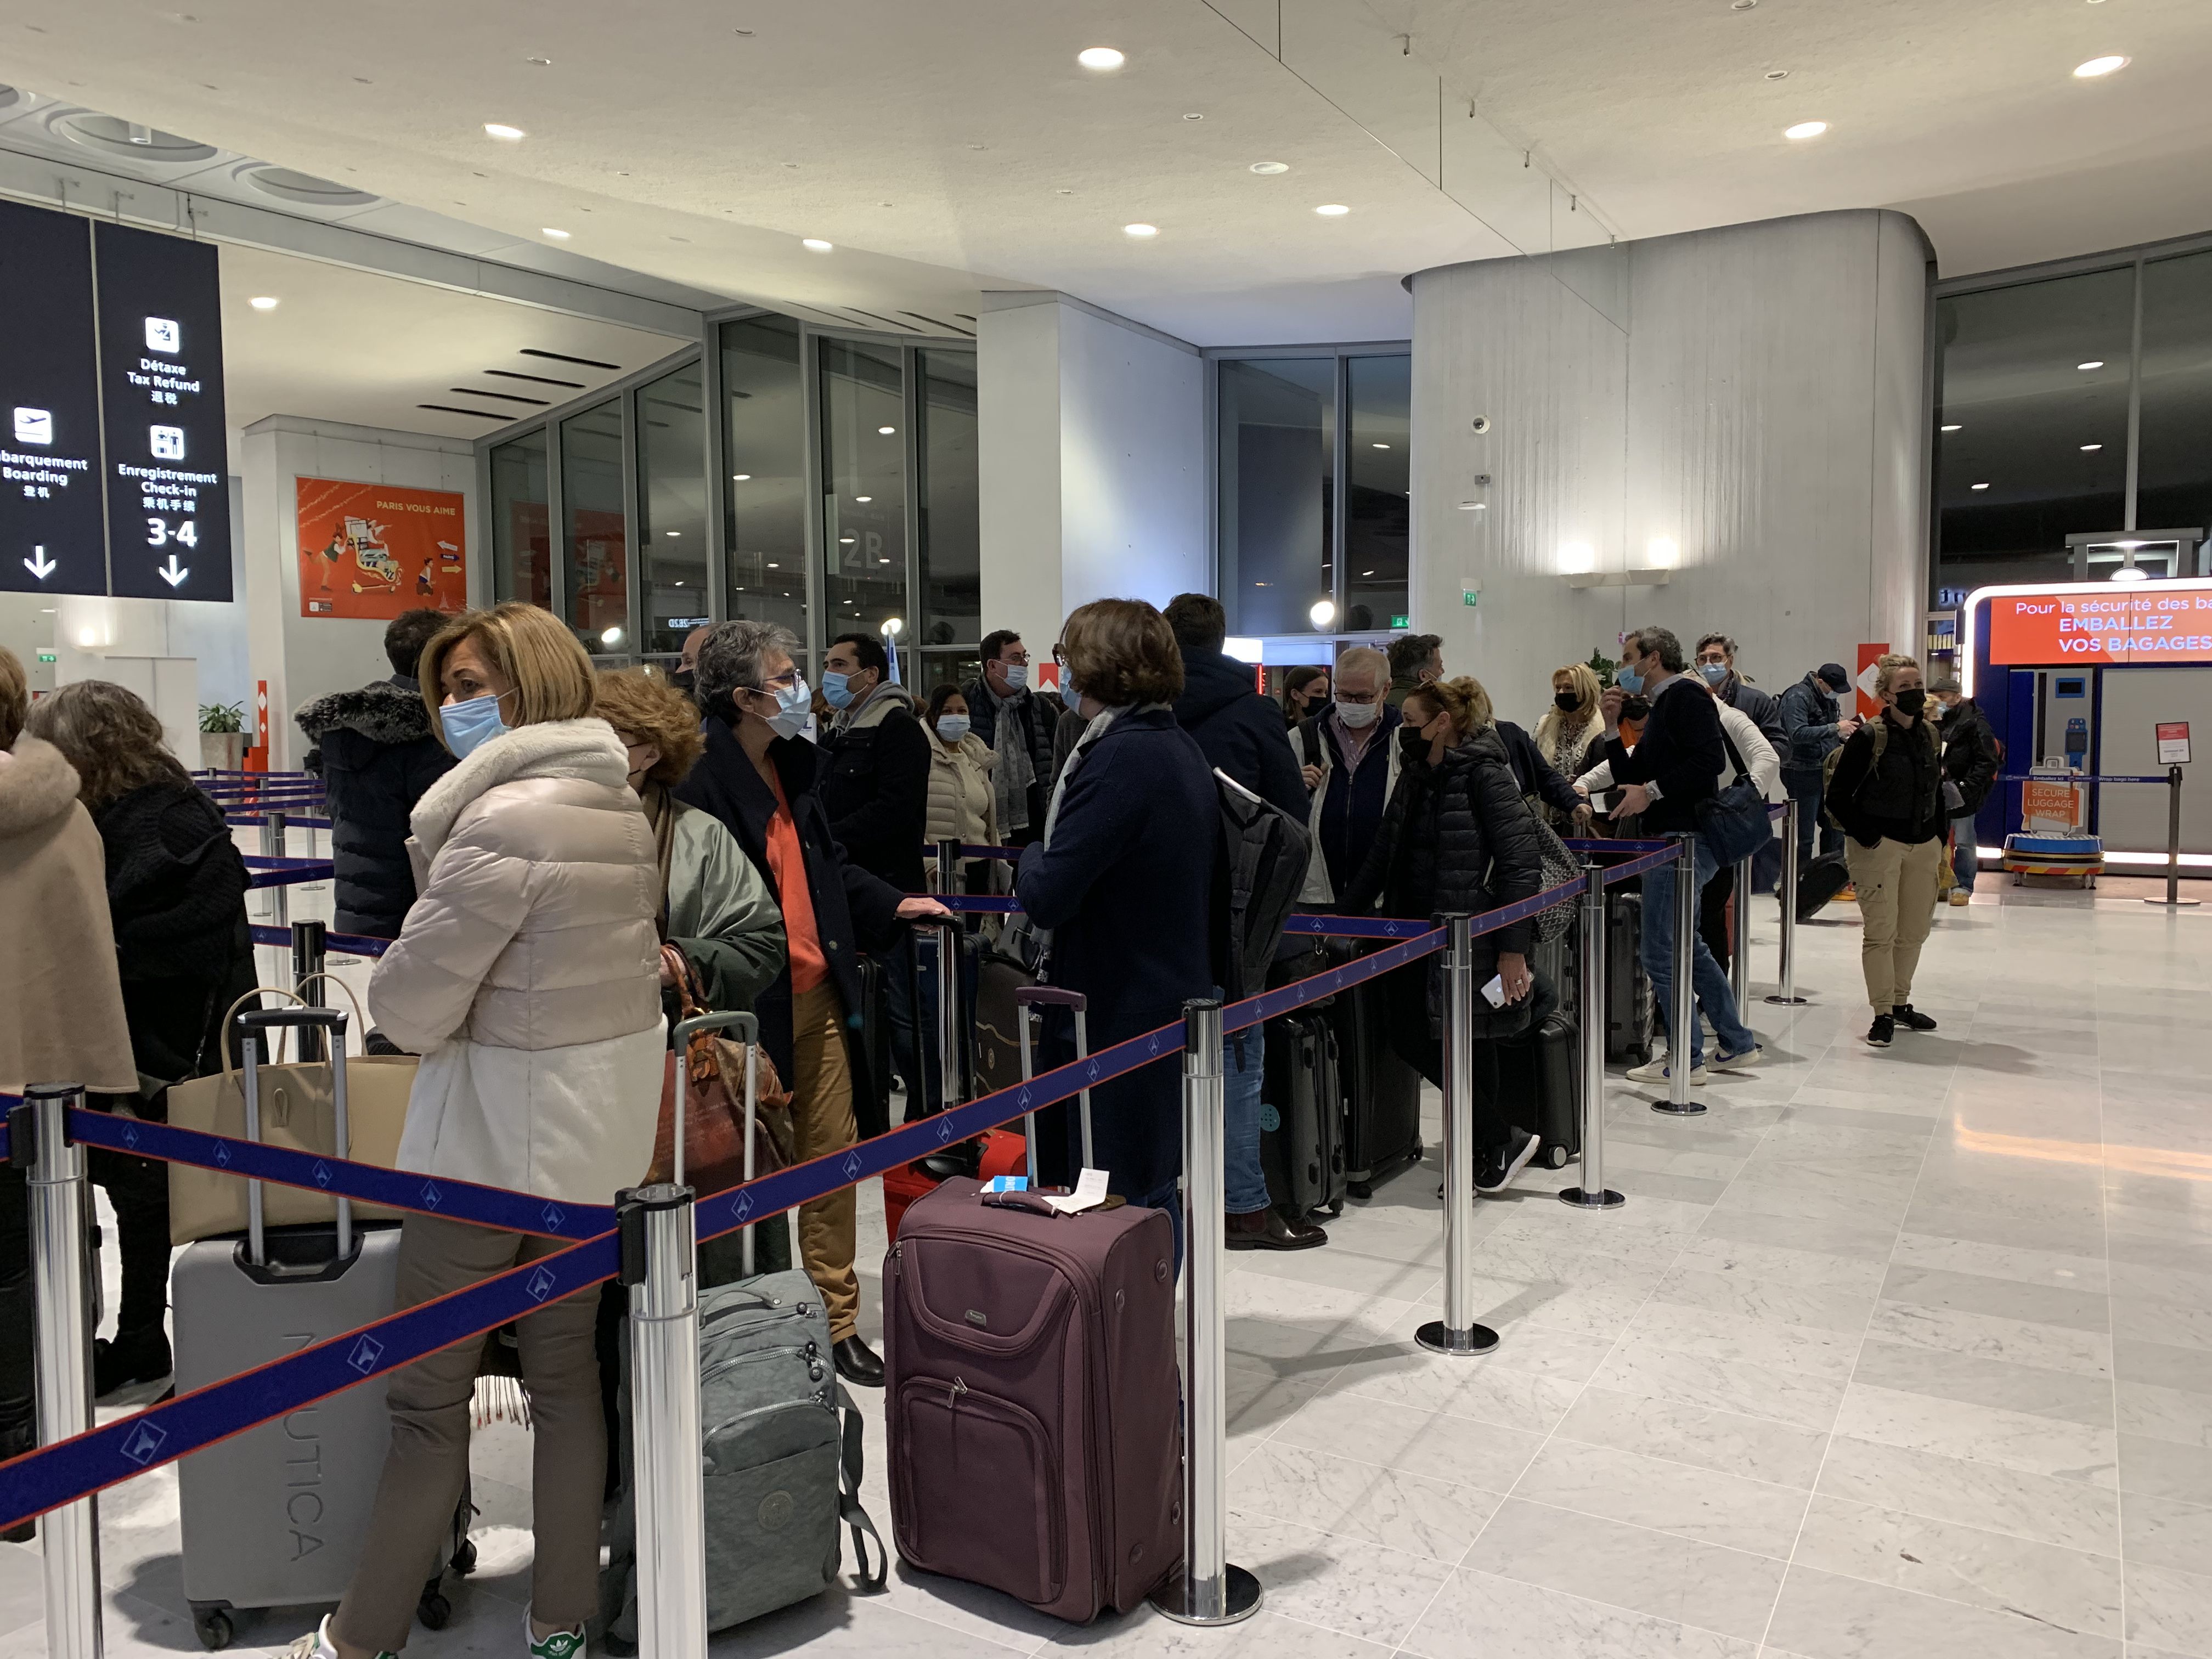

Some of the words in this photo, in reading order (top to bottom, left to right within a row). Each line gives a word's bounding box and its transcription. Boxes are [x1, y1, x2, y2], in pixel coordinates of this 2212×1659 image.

[140, 358, 186, 375] Détaxe
[127, 371, 150, 386] Tax
[153, 375, 200, 392] Refund
[151, 390, 178, 405] 退税
[0, 449, 88, 471] barquement
[3, 466, 68, 487] Boarding
[118, 463, 217, 484] Enregistrement
[23, 484, 50, 499] 登机
[141, 481, 197, 497] Check-in
[376, 500, 404, 511] PARIS
[406, 503, 431, 514] VOUS
[433, 506, 456, 516] AIME
[148, 517, 198, 548] 3-4
[2016, 601, 2056, 615] Pour
[2061, 600, 2075, 613] la
[2080, 597, 2152, 613] sécurité
[2157, 597, 2190, 611] des
[2059, 615, 2173, 632] EMBALLEZ
[2058, 638, 2102, 653] VOS
[2108, 635, 2212, 652] BAGAGES
[2032, 788, 2070, 798] SECURE
[2027, 799, 2074, 808] LUGGAGE
[2035, 809, 2066, 817] WRAP
[281, 1333, 324, 1562] NUTICA
